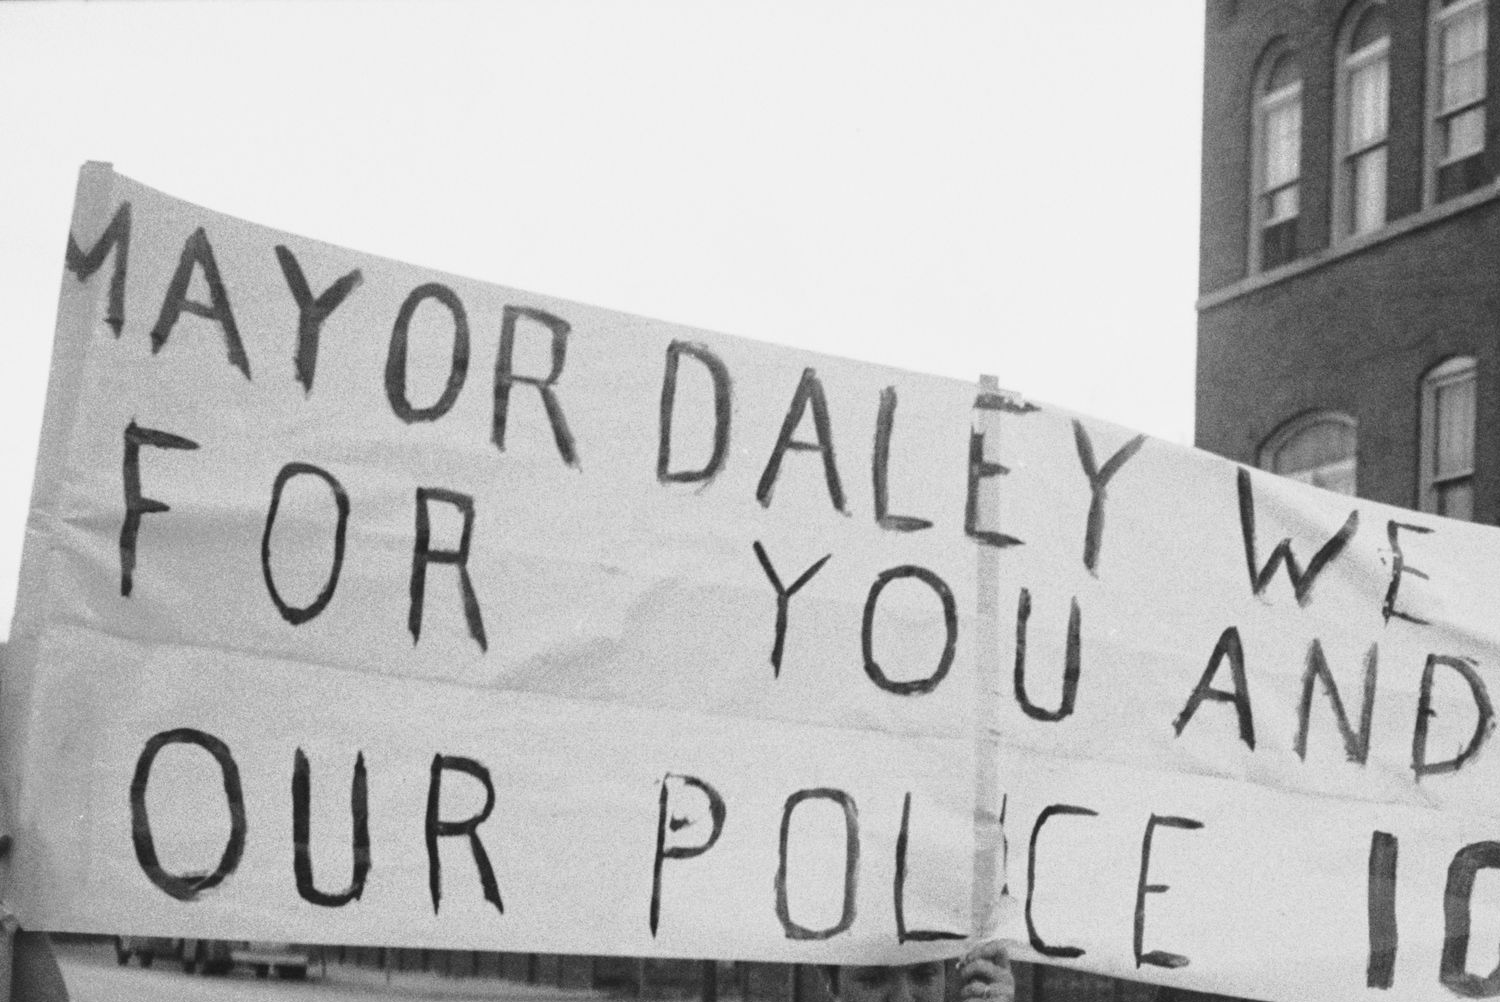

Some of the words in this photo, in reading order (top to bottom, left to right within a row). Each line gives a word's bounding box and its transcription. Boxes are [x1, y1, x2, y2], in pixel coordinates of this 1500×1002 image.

[66, 201, 582, 472] MAYOR
[657, 338, 1146, 579] DALEY
[1236, 467, 1436, 627] WE
[119, 418, 487, 652] FOR
[752, 539, 1081, 722] YOU
[1173, 626, 1498, 783] AND
[131, 727, 504, 916] OUR
[648, 772, 1205, 969] POLCE
